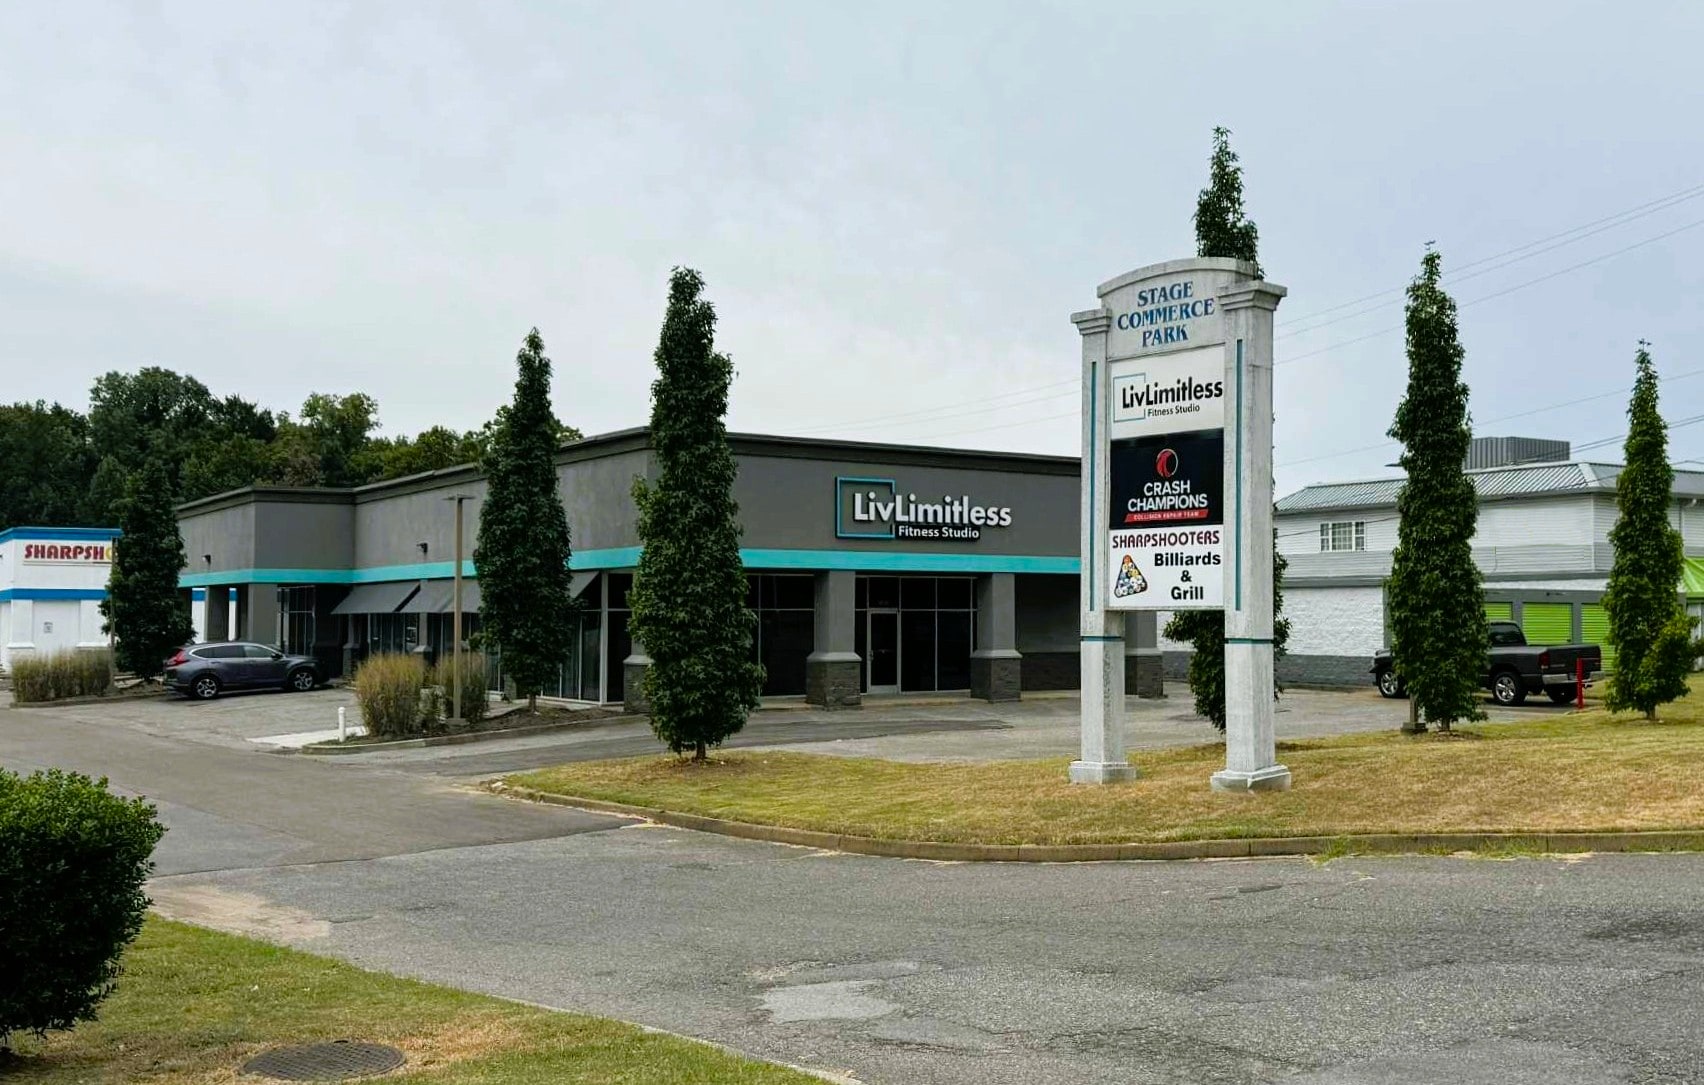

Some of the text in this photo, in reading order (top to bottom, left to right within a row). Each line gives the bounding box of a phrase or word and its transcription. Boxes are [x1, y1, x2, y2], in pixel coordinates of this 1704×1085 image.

[1137, 281, 1194, 307] STAGE
[1117, 298, 1216, 330] COMMERCE
[1142, 324, 1189, 348] PARK
[1122, 376, 1223, 409] LivLimitless
[1147, 403, 1200, 417] Fitness Studio
[1143, 480, 1191, 497] CRASH
[854, 491, 1012, 527] LivLimitless
[1127, 493, 1208, 512] CHAMPIONS
[898, 525, 980, 539] Fitness Studio
[1112, 530, 1220, 549] SHARPSHOOTERS
[1154, 552, 1221, 567] Billiards
[1180, 570, 1192, 583] &
[1170, 586, 1204, 601] Grill
